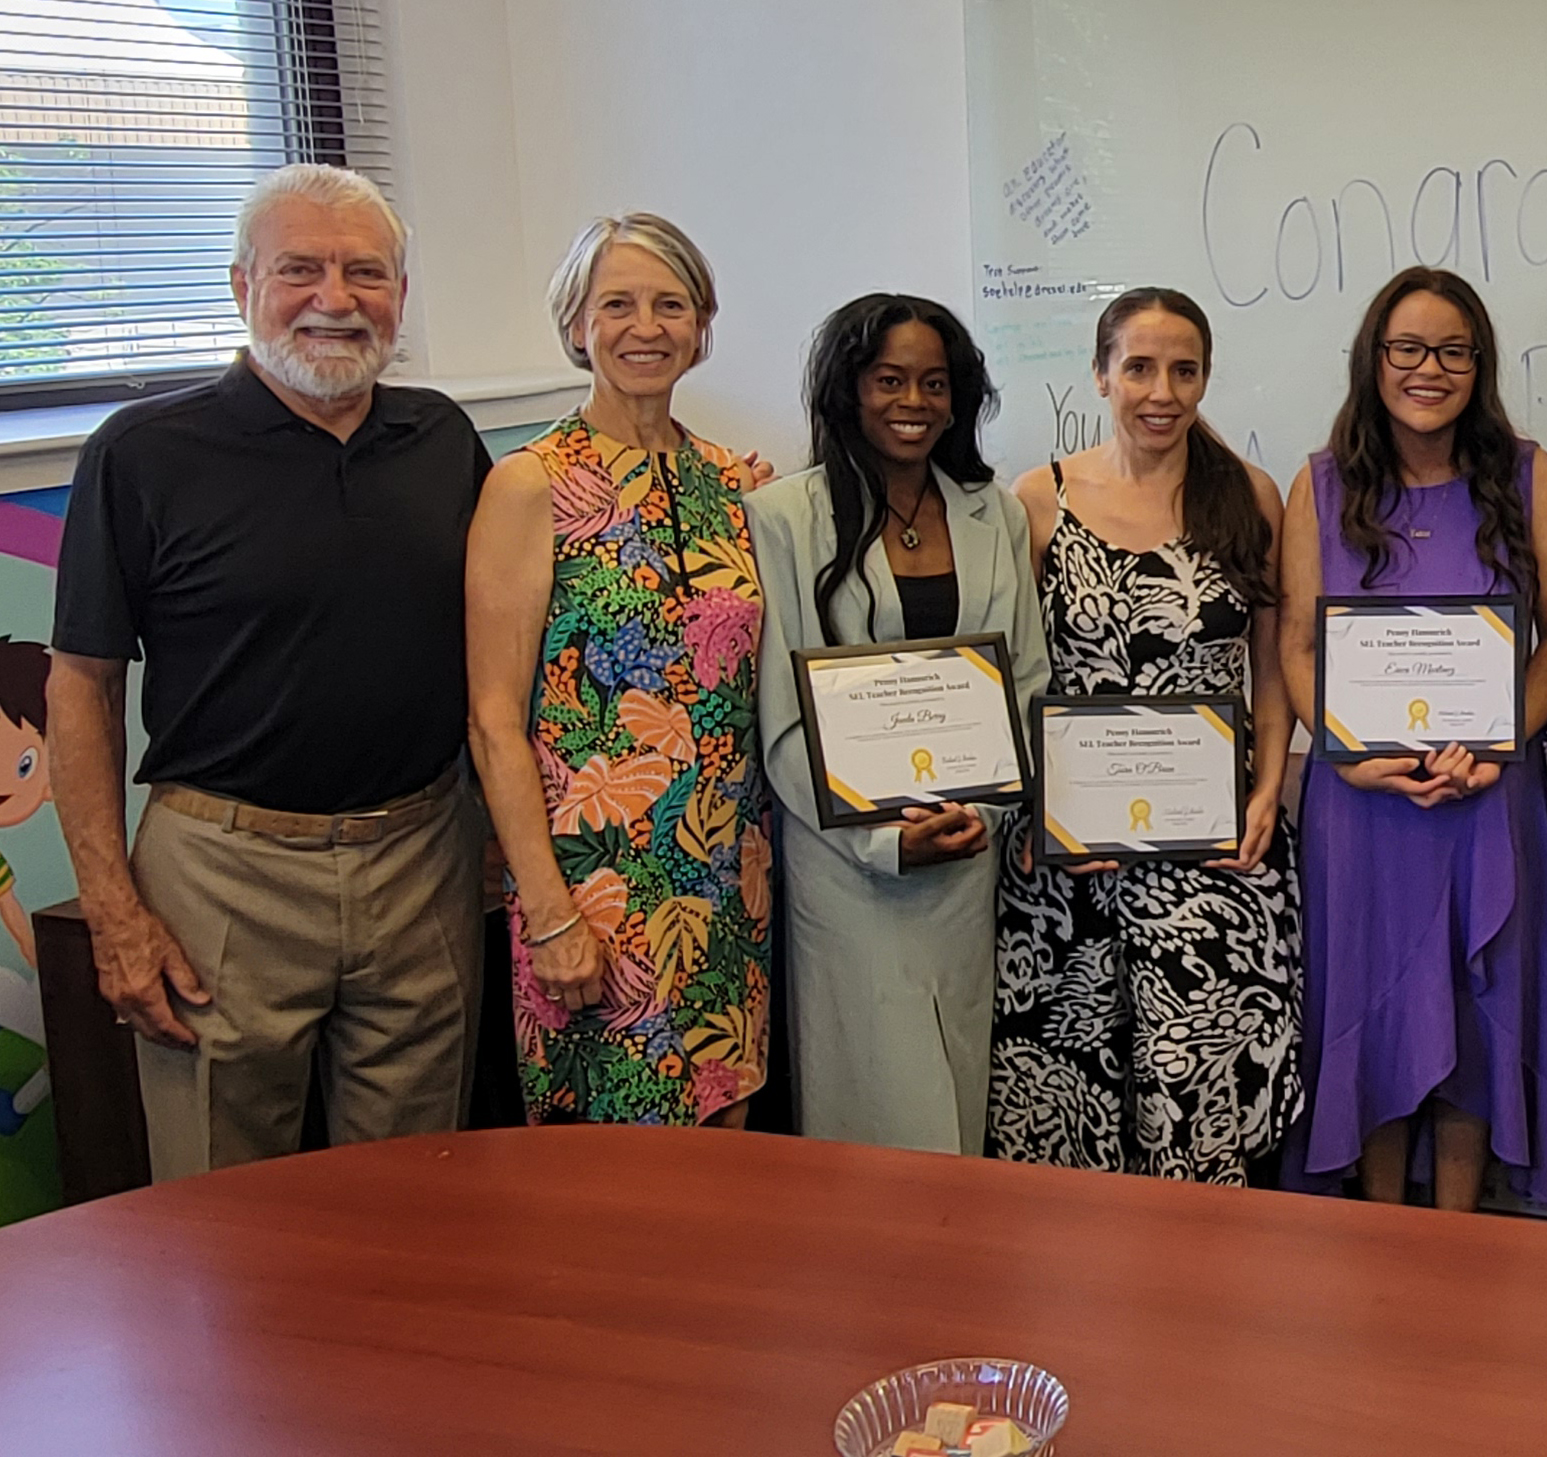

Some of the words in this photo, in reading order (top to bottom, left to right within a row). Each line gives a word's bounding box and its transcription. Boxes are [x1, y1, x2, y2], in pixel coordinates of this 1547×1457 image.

[1377, 640, 1407, 648] Teacher
[1409, 639, 1454, 649] Recognition
[1456, 638, 1480, 647] Award
[867, 688, 898, 699] Teacher
[1096, 740, 1127, 748] Teacher
[1177, 738, 1201, 747] Award
